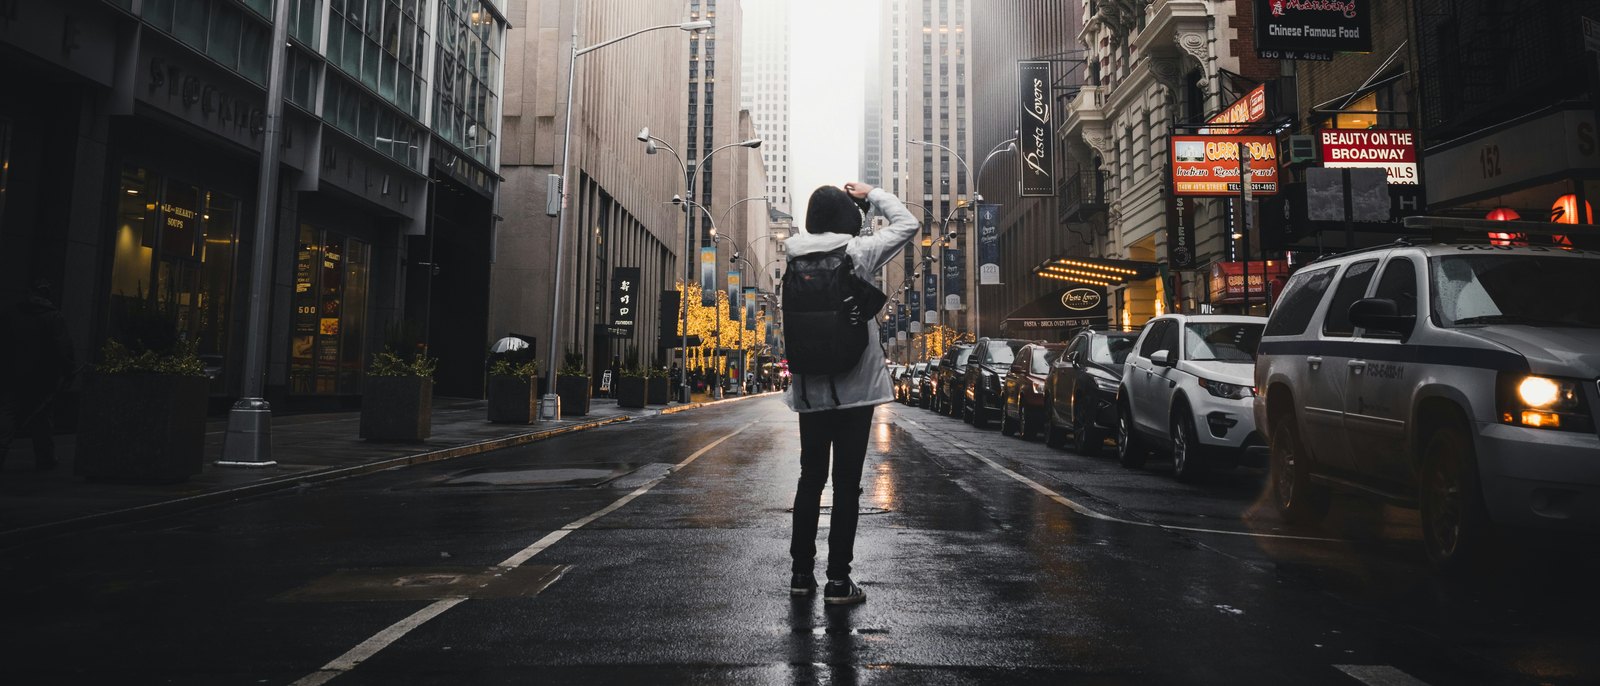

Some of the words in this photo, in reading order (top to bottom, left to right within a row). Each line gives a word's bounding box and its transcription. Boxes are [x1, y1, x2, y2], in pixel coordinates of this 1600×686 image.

[1269, 24, 1302, 36] Chinese
[1304, 25, 1337, 38] Famous
[1338, 26, 1360, 38] Food
[1261, 50, 1279, 59] 150
[1285, 51, 1298, 60] W.
[1023, 78, 1050, 124] Lovers
[1322, 132, 1367, 146] BEAUTY
[1370, 132, 1389, 146] ON
[1390, 133, 1413, 146] THE
[1023, 127, 1050, 177] Pasta
[1245, 142, 1275, 160] NDIA
[1332, 148, 1406, 160] BROADWAY
[1480, 143, 1501, 179] 152
[1177, 166, 1209, 177] Indian
[1213, 165, 1276, 178] Restrant
[1387, 166, 1414, 179] AILS
[298, 306, 316, 314] 500
